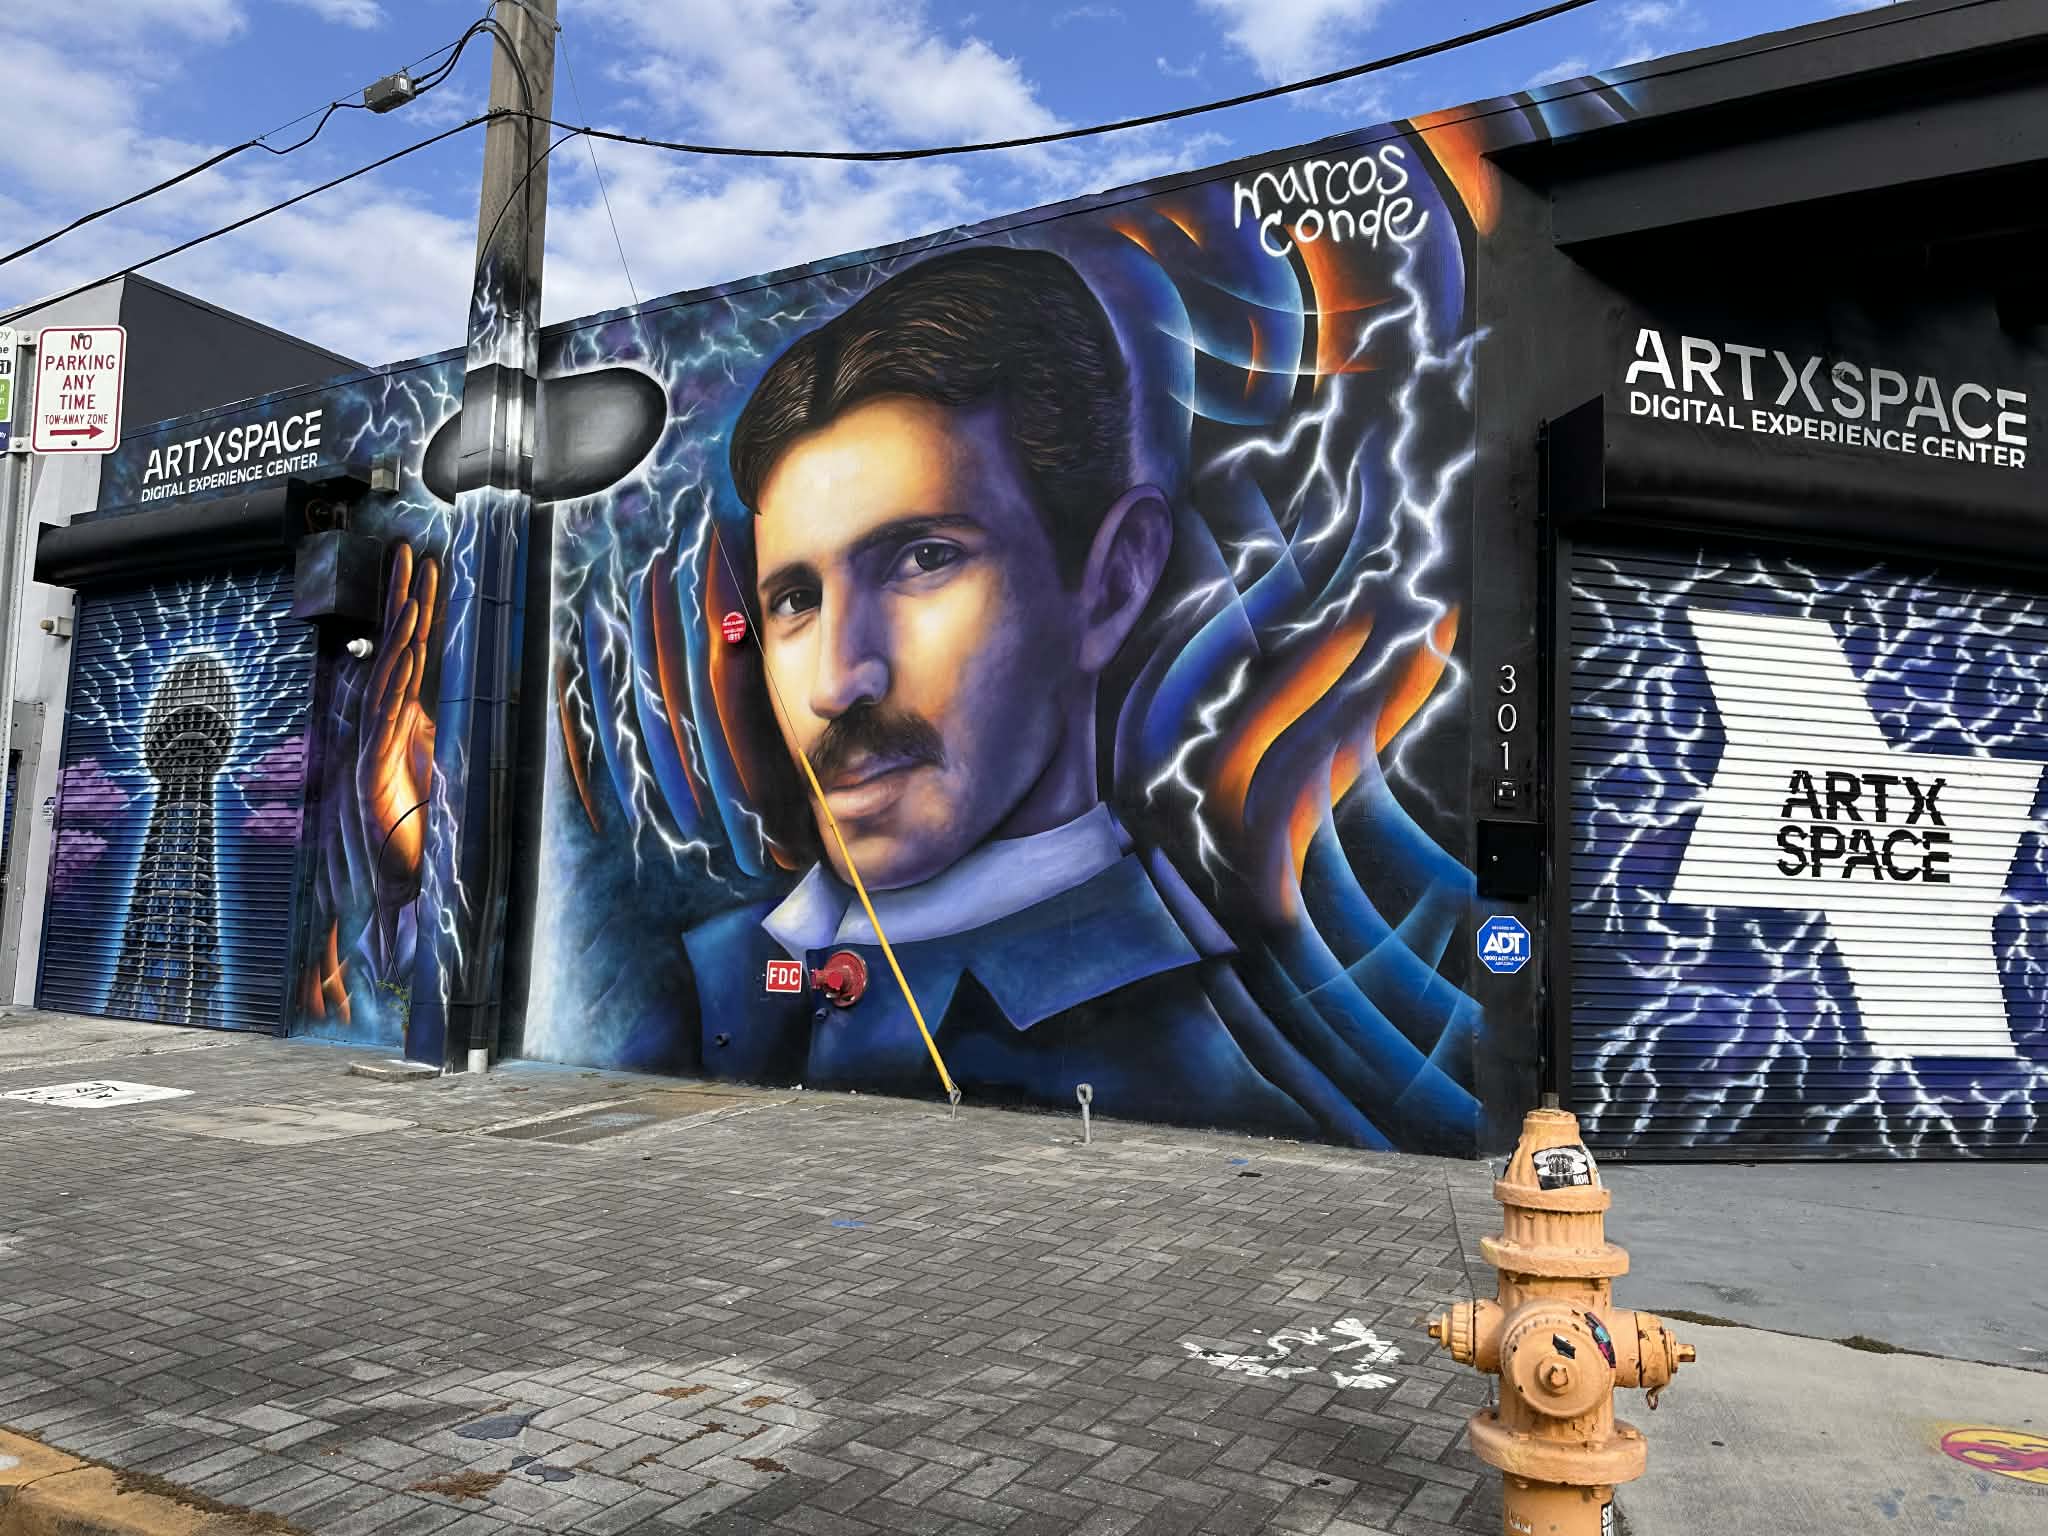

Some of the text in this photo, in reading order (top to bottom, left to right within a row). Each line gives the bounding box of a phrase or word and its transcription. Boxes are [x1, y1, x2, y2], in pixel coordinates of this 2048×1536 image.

[70, 333, 93, 350] NO
[45, 354, 116, 371] PARKING
[62, 374, 96, 390] ANY
[59, 394, 97, 410] TIME
[45, 413, 109, 425] TOW-AWAY ZONE
[1629, 390, 2026, 469] DIGITAL EXPERIENCE CENTER
[141, 452, 318, 503] DIGITAL EXPERIENCE CENTER
[1781, 769, 1948, 826] ARTX
[1776, 824, 1952, 883] SPACE
[1483, 931, 1525, 954] ADT
[769, 967, 799, 986] FDC
